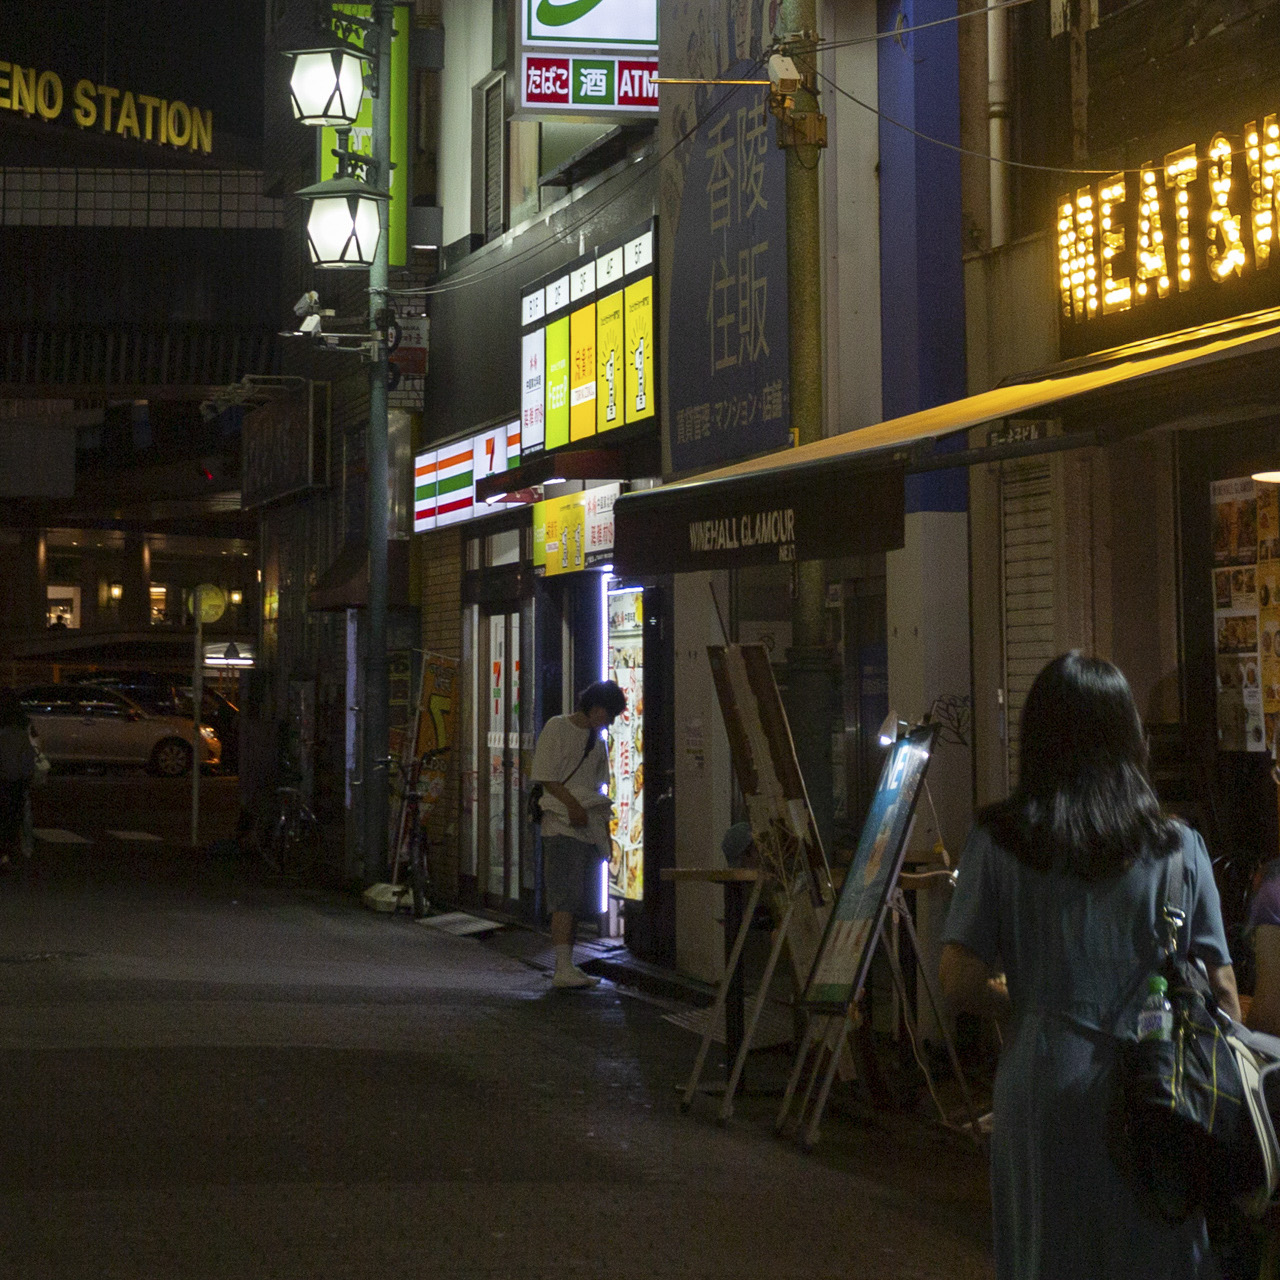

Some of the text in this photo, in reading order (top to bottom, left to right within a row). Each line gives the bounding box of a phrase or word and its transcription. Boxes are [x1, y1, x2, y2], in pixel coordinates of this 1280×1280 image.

[527, 66, 659, 98] たばこ 酒 ATM
[73, 78, 213, 154] STATION
[689, 508, 795, 552] WINEHALL GLAMOUR
